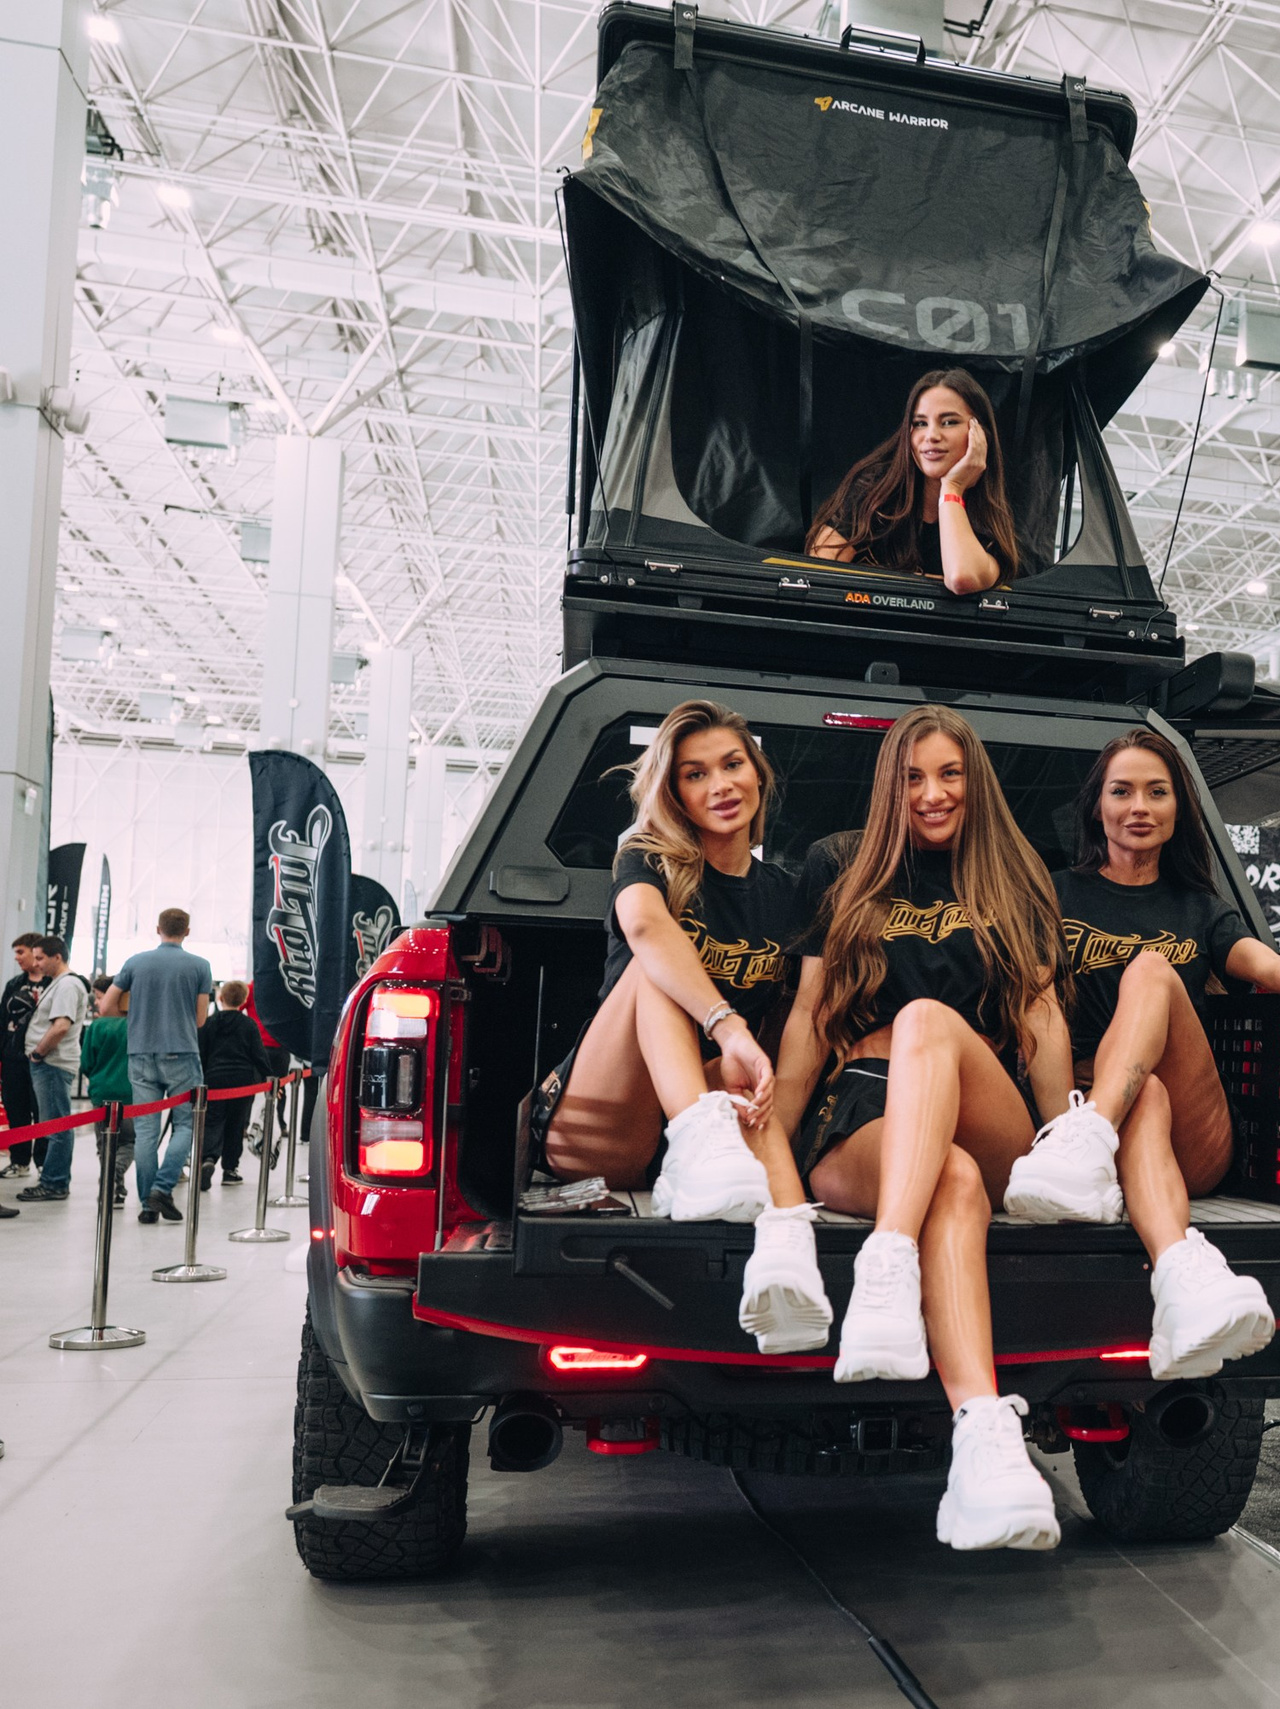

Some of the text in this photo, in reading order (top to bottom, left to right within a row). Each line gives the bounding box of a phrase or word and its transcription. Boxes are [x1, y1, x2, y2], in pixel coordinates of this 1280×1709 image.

[832, 101, 948, 130] ARCANE WARRIOR
[845, 592, 935, 610] ADA OVERLAND
